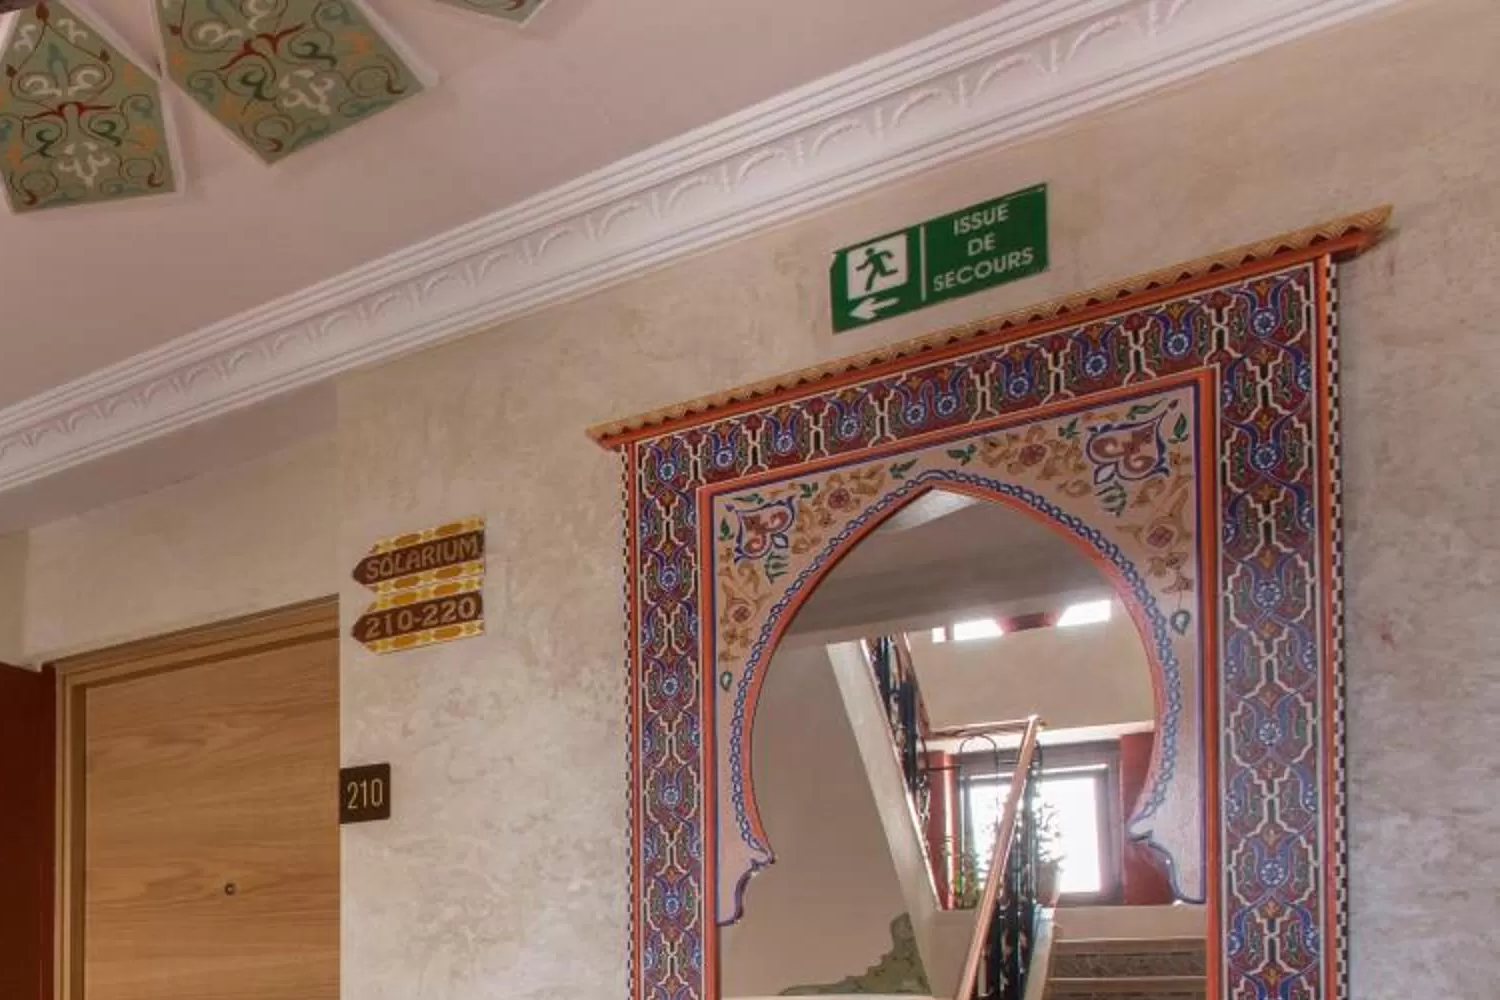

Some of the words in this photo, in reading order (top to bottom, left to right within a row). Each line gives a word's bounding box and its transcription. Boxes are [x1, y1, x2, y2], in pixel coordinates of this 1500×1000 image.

[953, 203, 1009, 236] ISSUE
[968, 233, 996, 256] DE
[933, 247, 1034, 292] SECOURS
[365, 534, 478, 580] SOLARIUM
[364, 597, 476, 639] 210-220
[347, 778, 383, 809] 210
